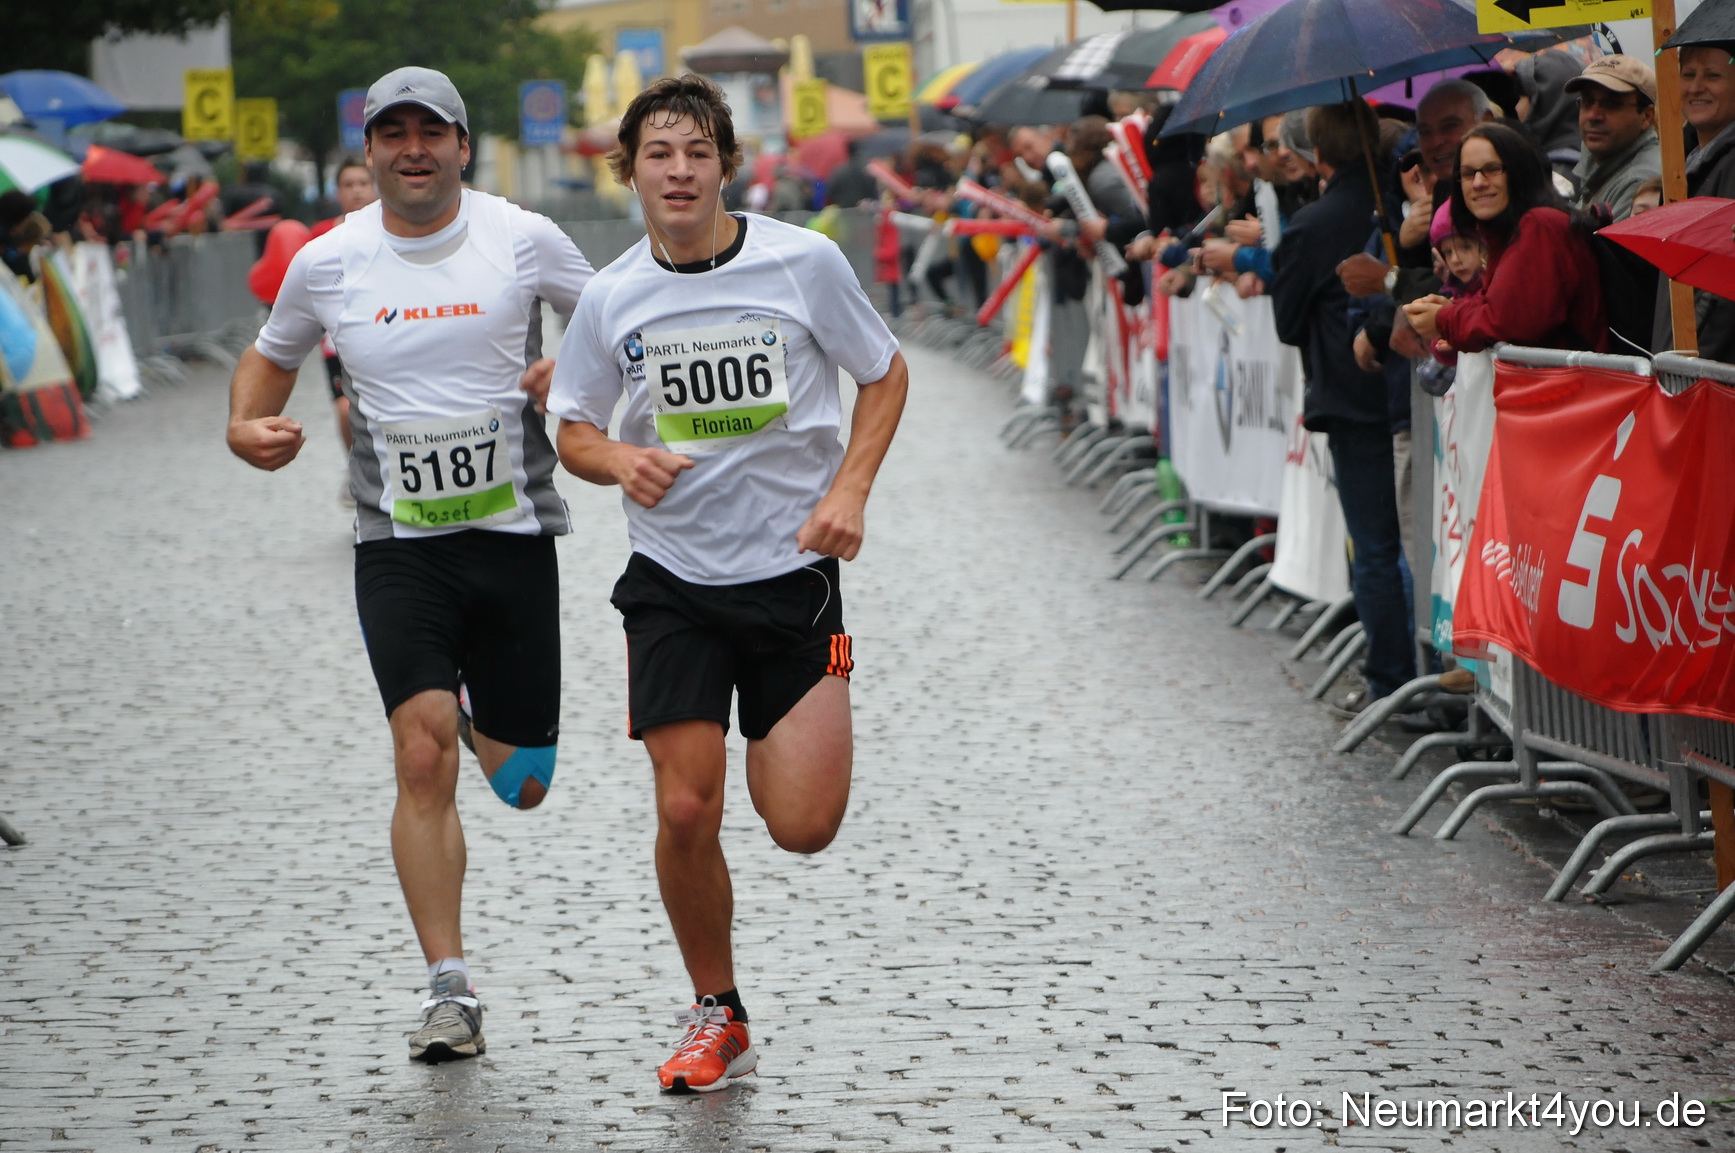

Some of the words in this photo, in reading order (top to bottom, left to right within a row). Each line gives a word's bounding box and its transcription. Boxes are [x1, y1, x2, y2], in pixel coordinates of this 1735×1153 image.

[876, 65, 903, 101] C
[194, 88, 222, 123] C
[403, 303, 486, 321] KLEBL
[645, 343, 690, 358] PARTL
[692, 335, 757, 353] Neumarkt
[660, 353, 773, 407] 5006
[385, 433, 422, 445] PARTL
[424, 426, 485, 444] Neumarkt
[692, 415, 753, 435] Florian
[399, 439, 497, 493] 5187
[410, 500, 472, 524] Josef
